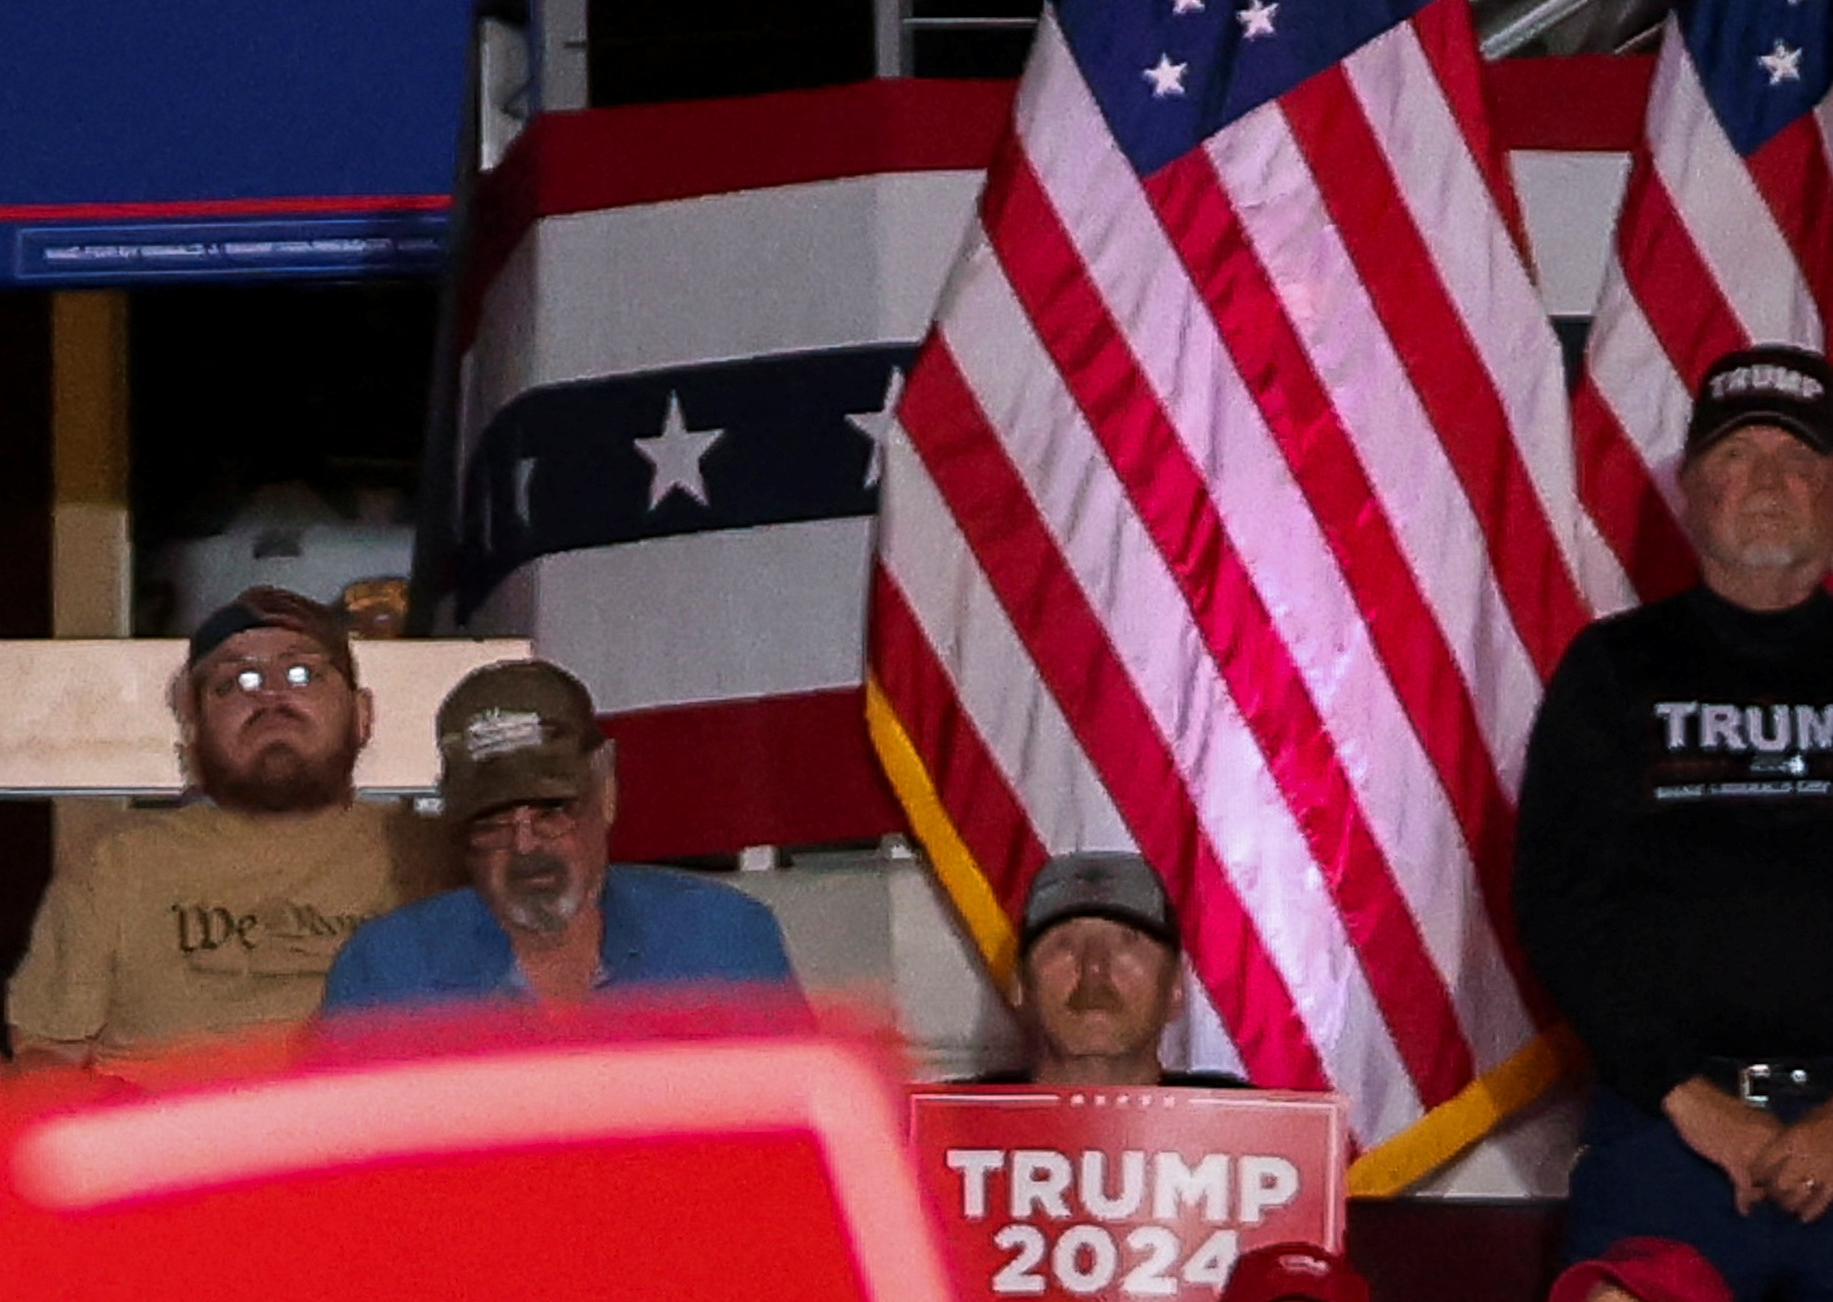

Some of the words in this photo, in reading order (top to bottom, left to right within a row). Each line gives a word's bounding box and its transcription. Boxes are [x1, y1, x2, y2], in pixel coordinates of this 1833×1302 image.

[1710, 364, 1824, 398] TRUMP
[1655, 702, 1833, 752] TRUM
[946, 1149, 1300, 1224] TRUMP
[992, 1223, 1240, 1296] 2024
